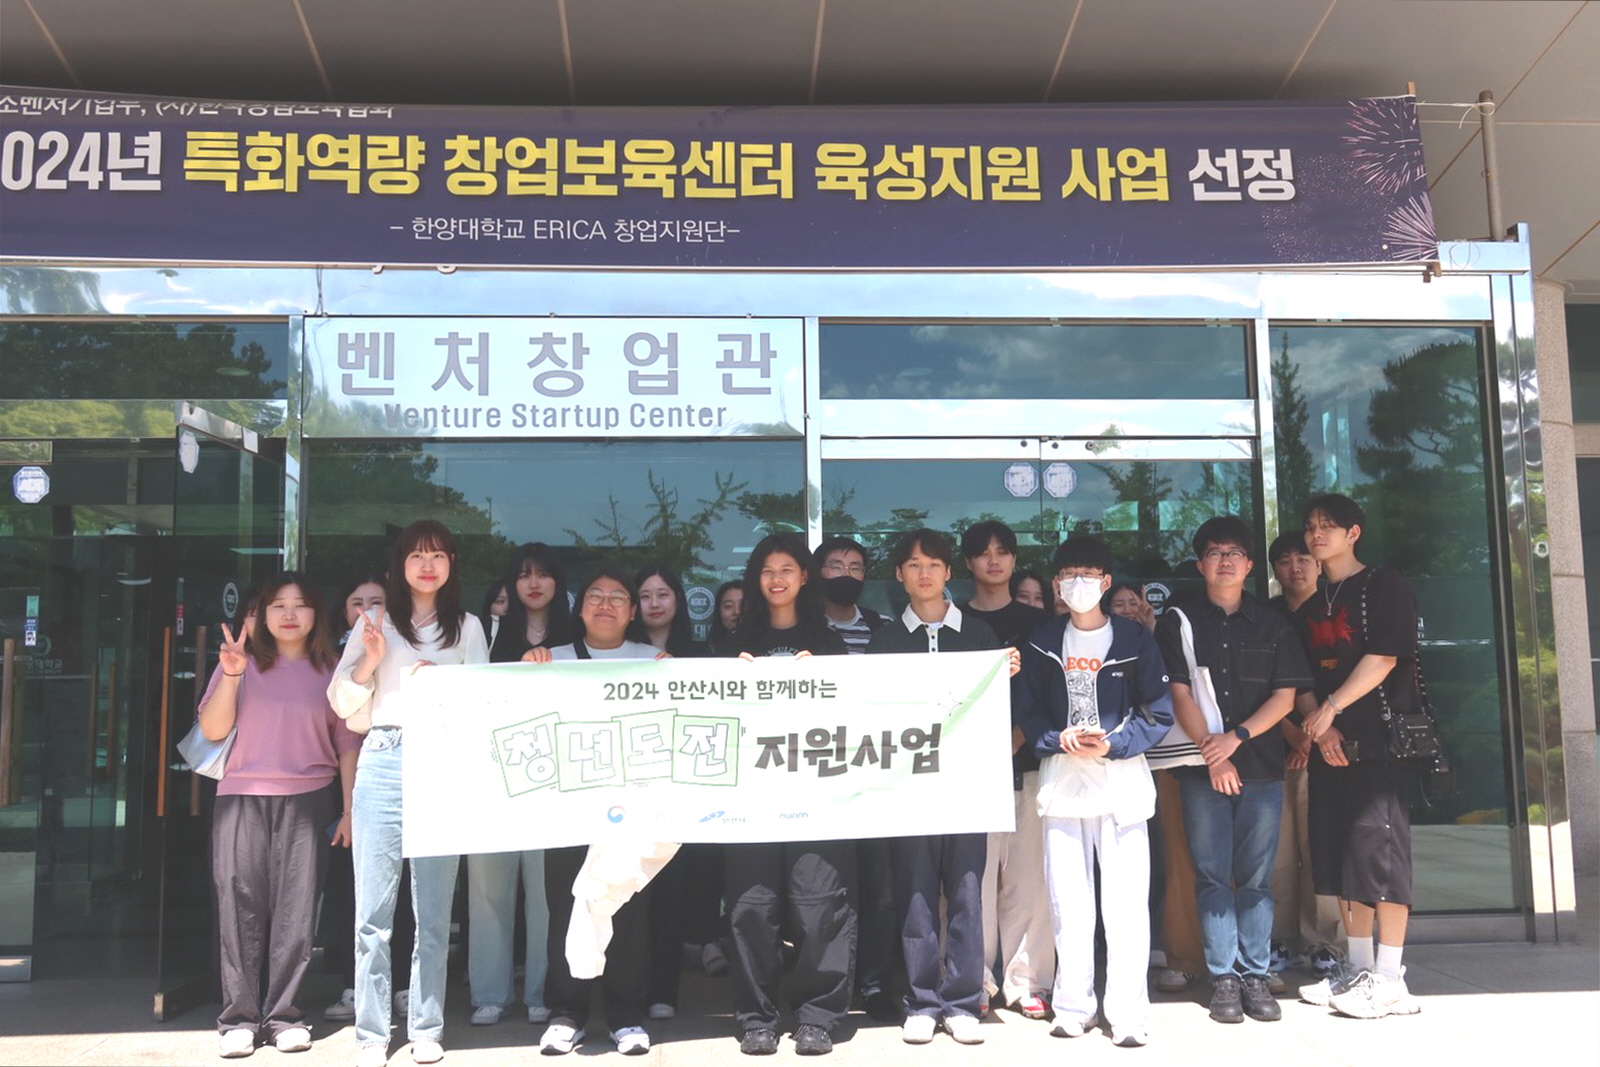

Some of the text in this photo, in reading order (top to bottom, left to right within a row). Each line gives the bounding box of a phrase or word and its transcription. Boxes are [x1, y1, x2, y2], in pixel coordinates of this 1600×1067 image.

[1, 130, 1296, 201] 024년 특화역량 창업보육센터 육성지원 사업 선정
[411, 217, 526, 241] 한양대학교
[533, 219, 607, 241] ERICA
[384, 402, 728, 431] Venture Startup Center
[1064, 656, 1102, 672] ECO
[603, 679, 838, 701] 2024 안산시와 함께하는
[502, 722, 943, 784] 청년도전 지원사업
